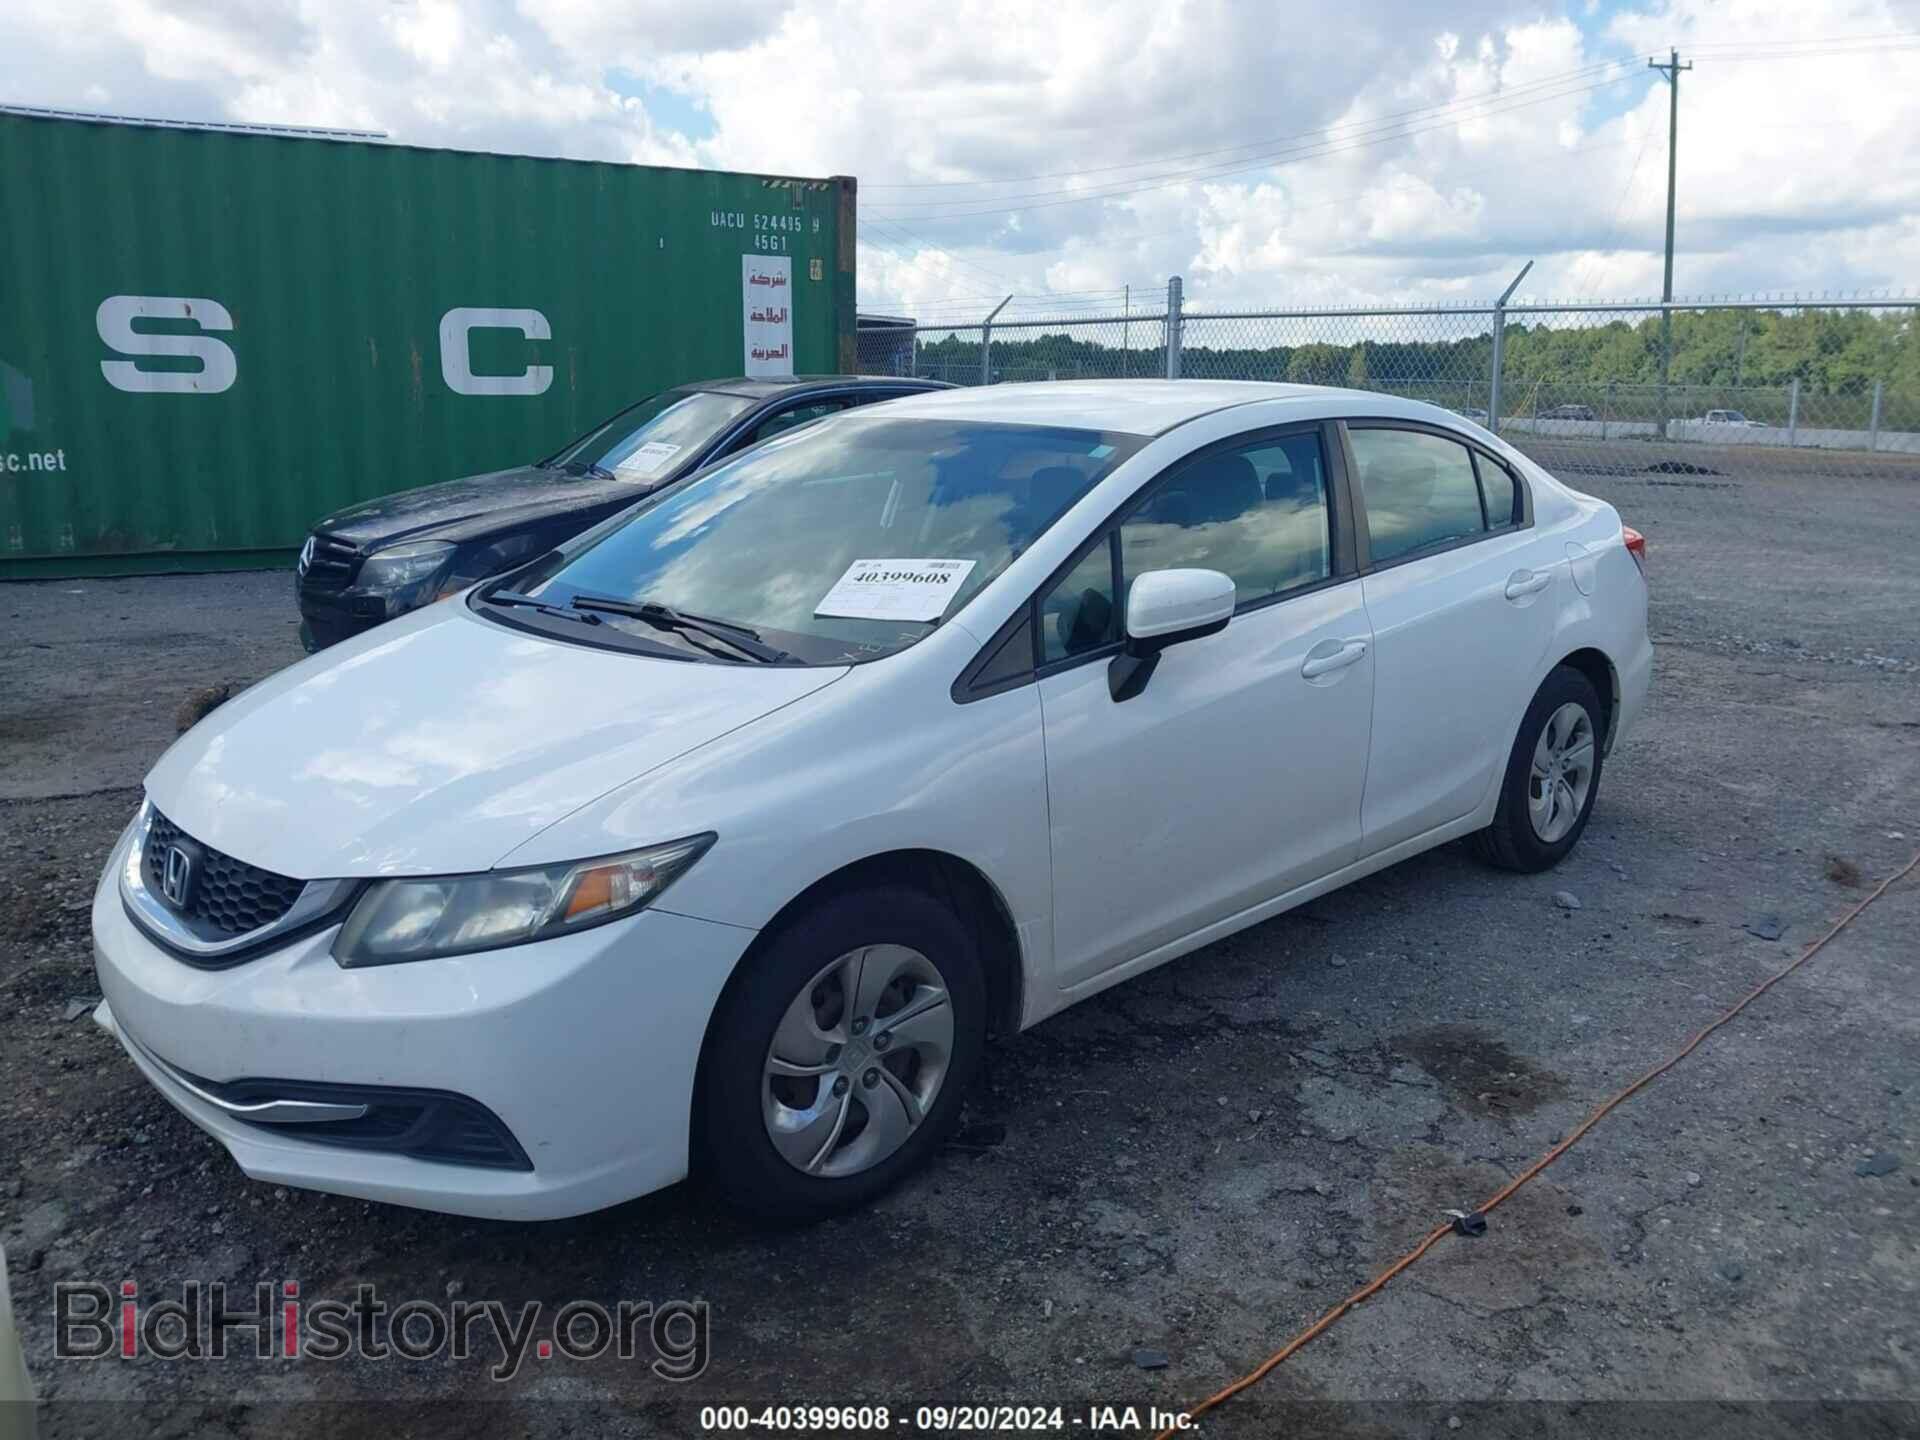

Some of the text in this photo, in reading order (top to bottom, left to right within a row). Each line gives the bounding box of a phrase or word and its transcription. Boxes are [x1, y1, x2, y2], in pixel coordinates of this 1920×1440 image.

[711, 211, 745, 229] UACU
[754, 235, 787, 250] 45G1
[750, 268, 786, 289] شركة
[750, 305, 787, 324] الملاحة
[96, 295, 555, 396] S C
[853, 571, 951, 585] 40399608
